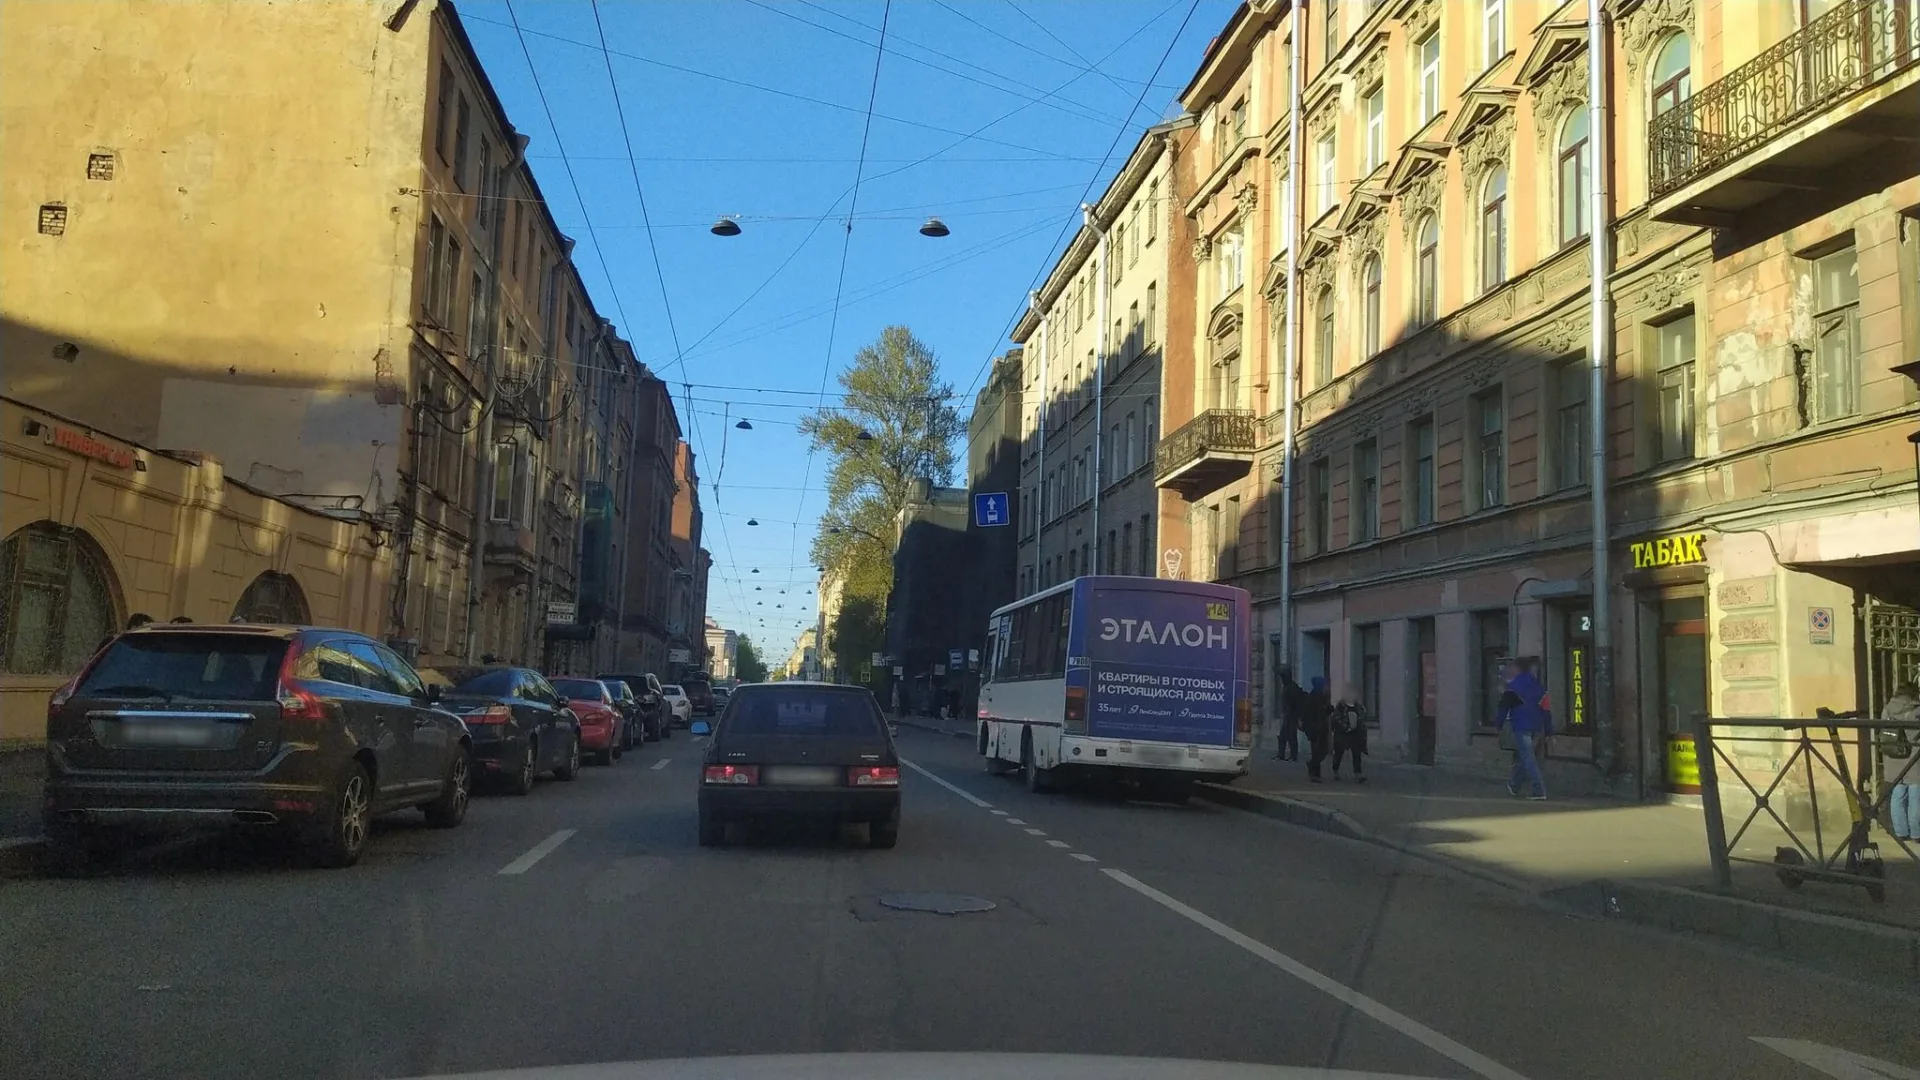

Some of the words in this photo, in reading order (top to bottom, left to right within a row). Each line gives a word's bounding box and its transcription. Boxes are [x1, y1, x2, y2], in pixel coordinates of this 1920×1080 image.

[1630, 534, 1702, 568] ТАБАК
[1581, 616, 1591, 631] 2
[1100, 617, 1228, 649] ЭТАЛОН
[1098, 672, 1160, 685] КВАРТИРЫ
[1162, 677, 1170, 686] В
[1172, 677, 1225, 690] ГОТОВЫХ
[1573, 650, 1583, 724] ТАБАК
[1098, 684, 1106, 693] И
[1107, 684, 1184, 699] СТРОЯЩИХСЯ
[1184, 691, 1225, 702] ДОМАХ
[1097, 703, 1109, 712] 35
